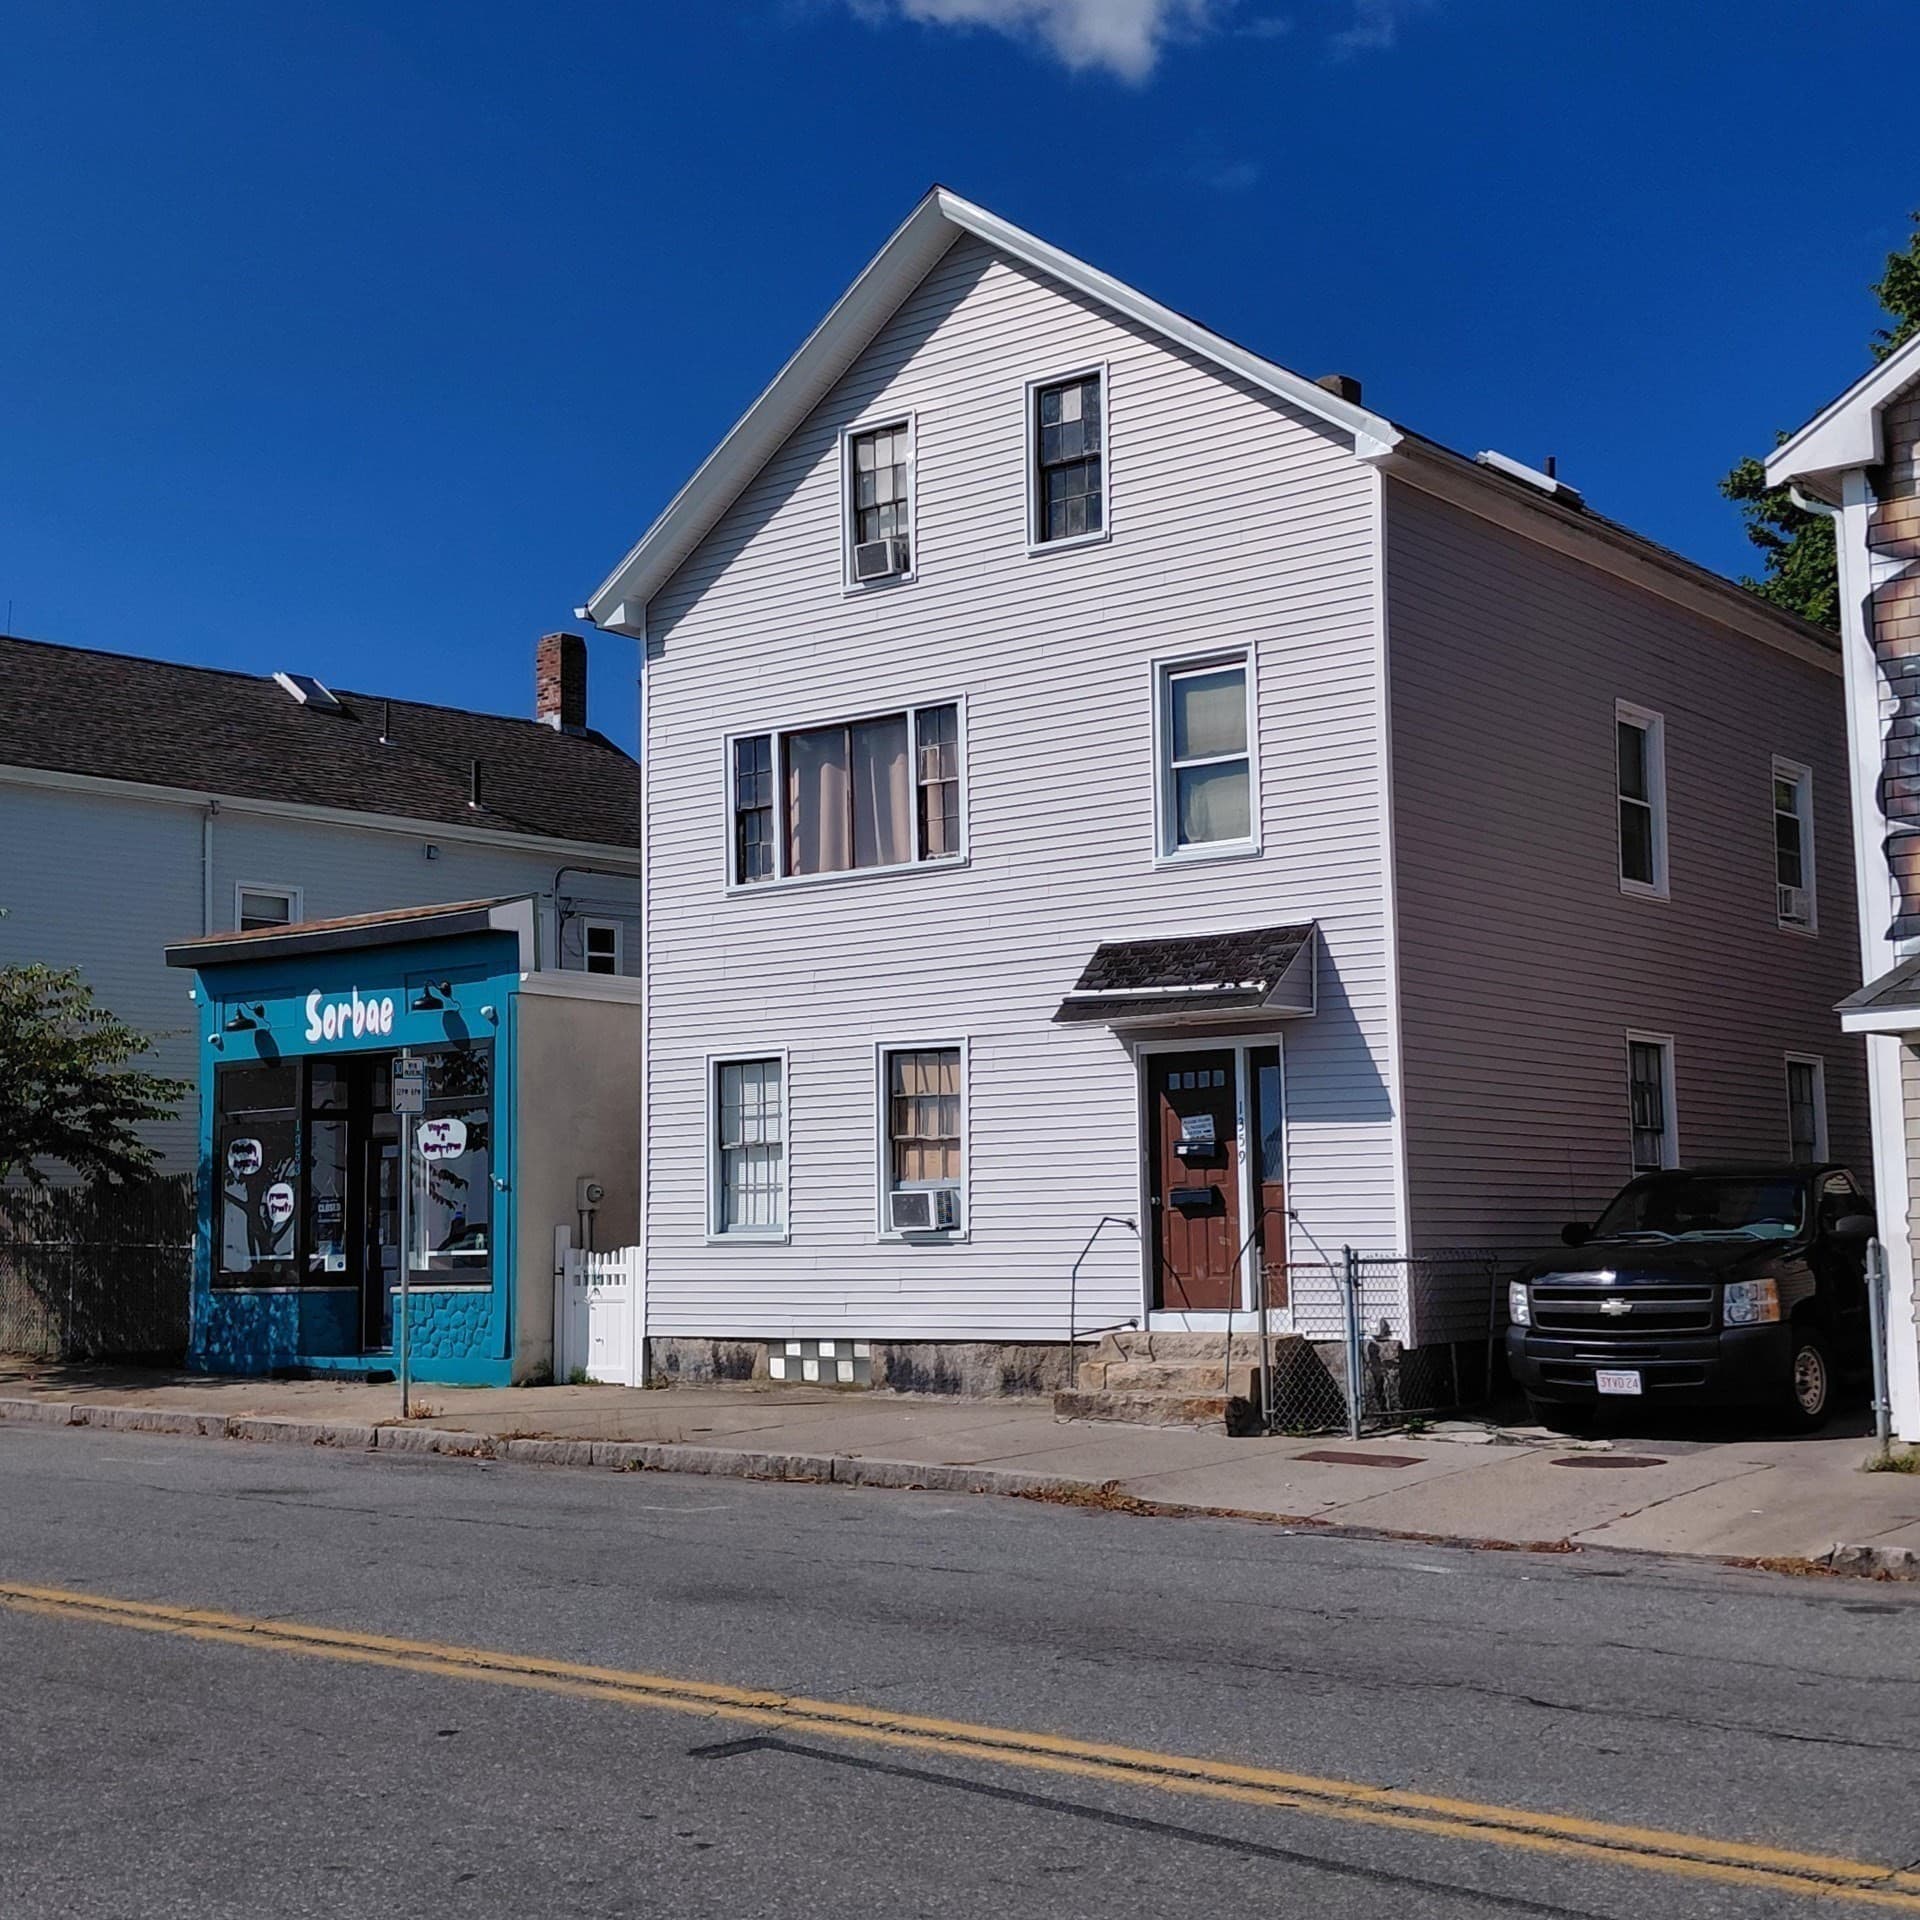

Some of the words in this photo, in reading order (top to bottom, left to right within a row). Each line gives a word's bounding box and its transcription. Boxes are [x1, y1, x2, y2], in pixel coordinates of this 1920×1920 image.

[305, 985, 394, 1043] Sorbae
[1237, 1101, 1246, 1165] 1359
[318, 1203, 341, 1213] CLOSED
